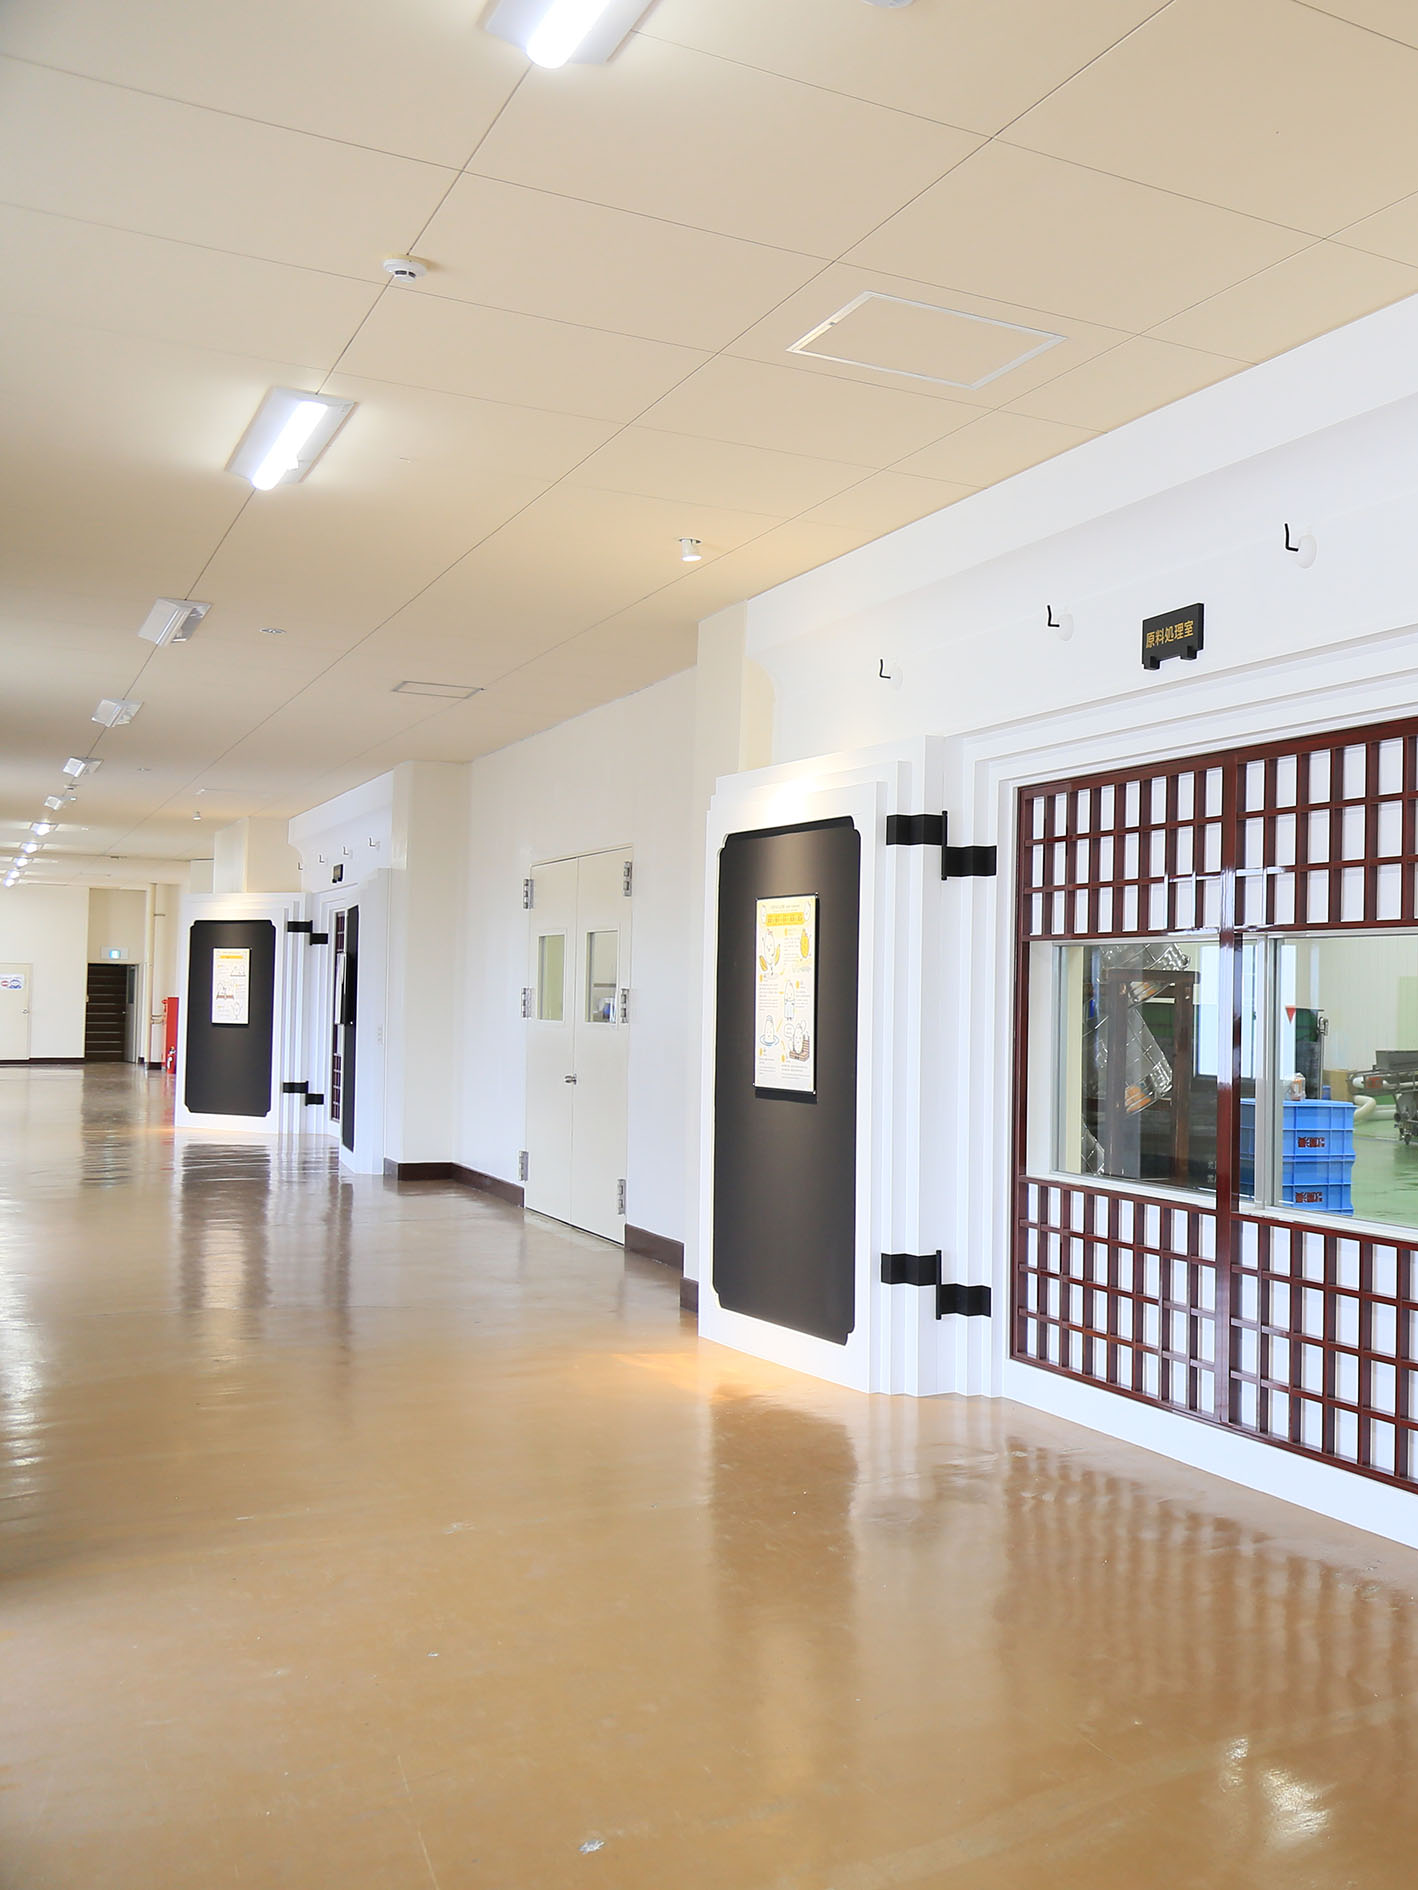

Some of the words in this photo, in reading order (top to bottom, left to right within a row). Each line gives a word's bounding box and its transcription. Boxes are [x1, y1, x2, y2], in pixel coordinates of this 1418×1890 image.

[1146, 620, 1194, 648] 原料処理室
